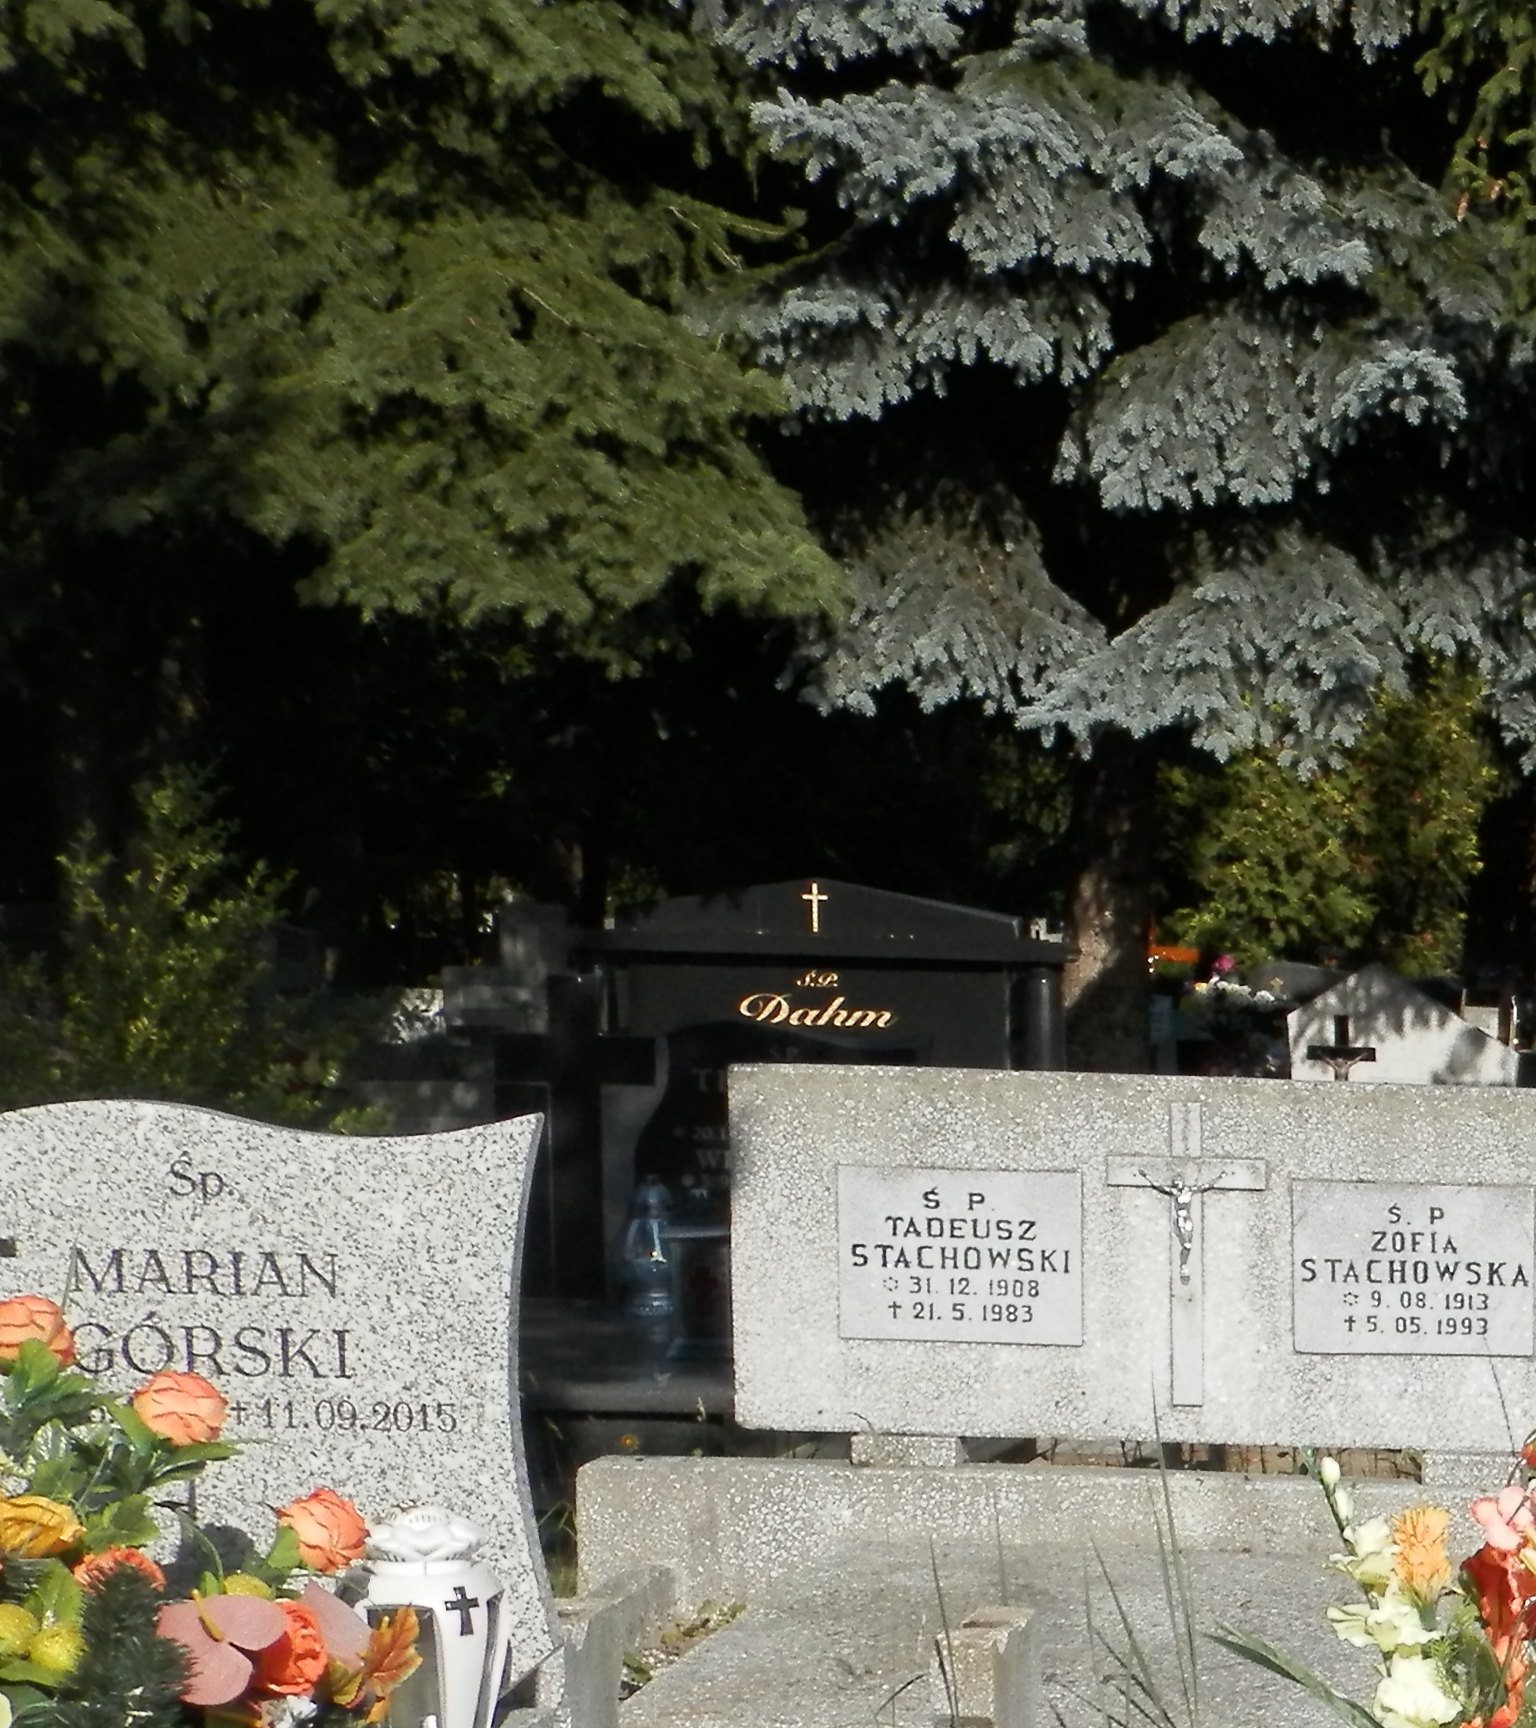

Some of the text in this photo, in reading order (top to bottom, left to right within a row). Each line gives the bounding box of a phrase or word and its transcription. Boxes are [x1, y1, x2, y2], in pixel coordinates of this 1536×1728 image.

[739, 993, 898, 1028] Dahm
[885, 1216, 1036, 1241] TADEUSZ
[1371, 1231, 1457, 1254] ZOFIA
[71, 1247, 338, 1298] MARIAN
[851, 1243, 1070, 1274] STACHOWSKI
[1300, 1258, 1529, 1287] STACHOWSKA
[71, 1311, 353, 1379] GÓRSKI
